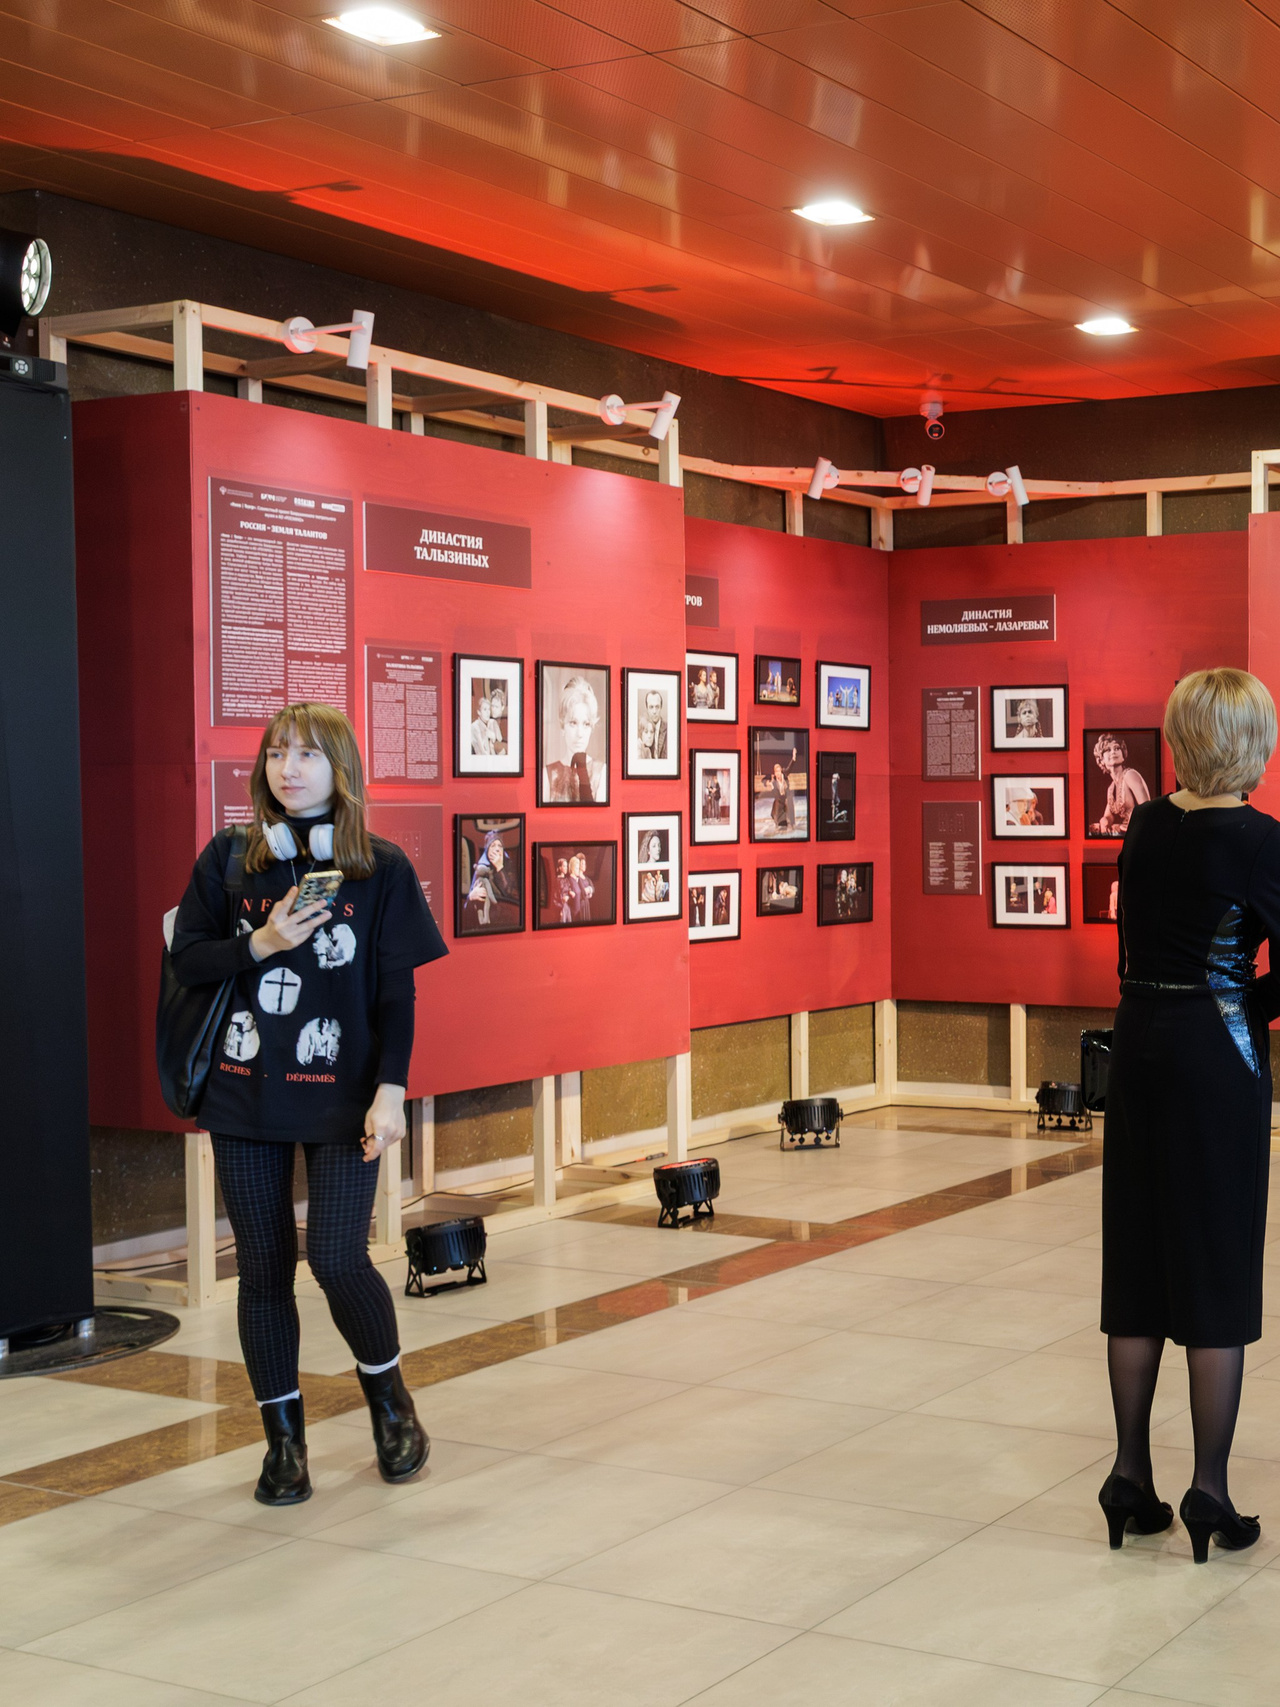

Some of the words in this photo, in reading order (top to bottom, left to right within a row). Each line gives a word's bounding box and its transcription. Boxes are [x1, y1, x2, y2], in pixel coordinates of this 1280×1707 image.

[240, 520, 267, 532] РОССИЯ
[271, 525, 294, 536] ЗЕМЛЯ
[294, 528, 328, 540] ТАЛАНТОВ
[419, 529, 483, 550] ДИНАСТИЯ
[414, 546, 489, 568] ТАЛЫЗИНЫХ
[961, 609, 1012, 622] ДИНАСТИЯ
[927, 622, 988, 634] НЕМОЛЯЕВЫХ
[994, 620, 1049, 631] ЛАЗАРЕВЫХ
[219, 1062, 251, 1076] RICHES
[286, 1072, 336, 1083] DÉPRIMÉS
